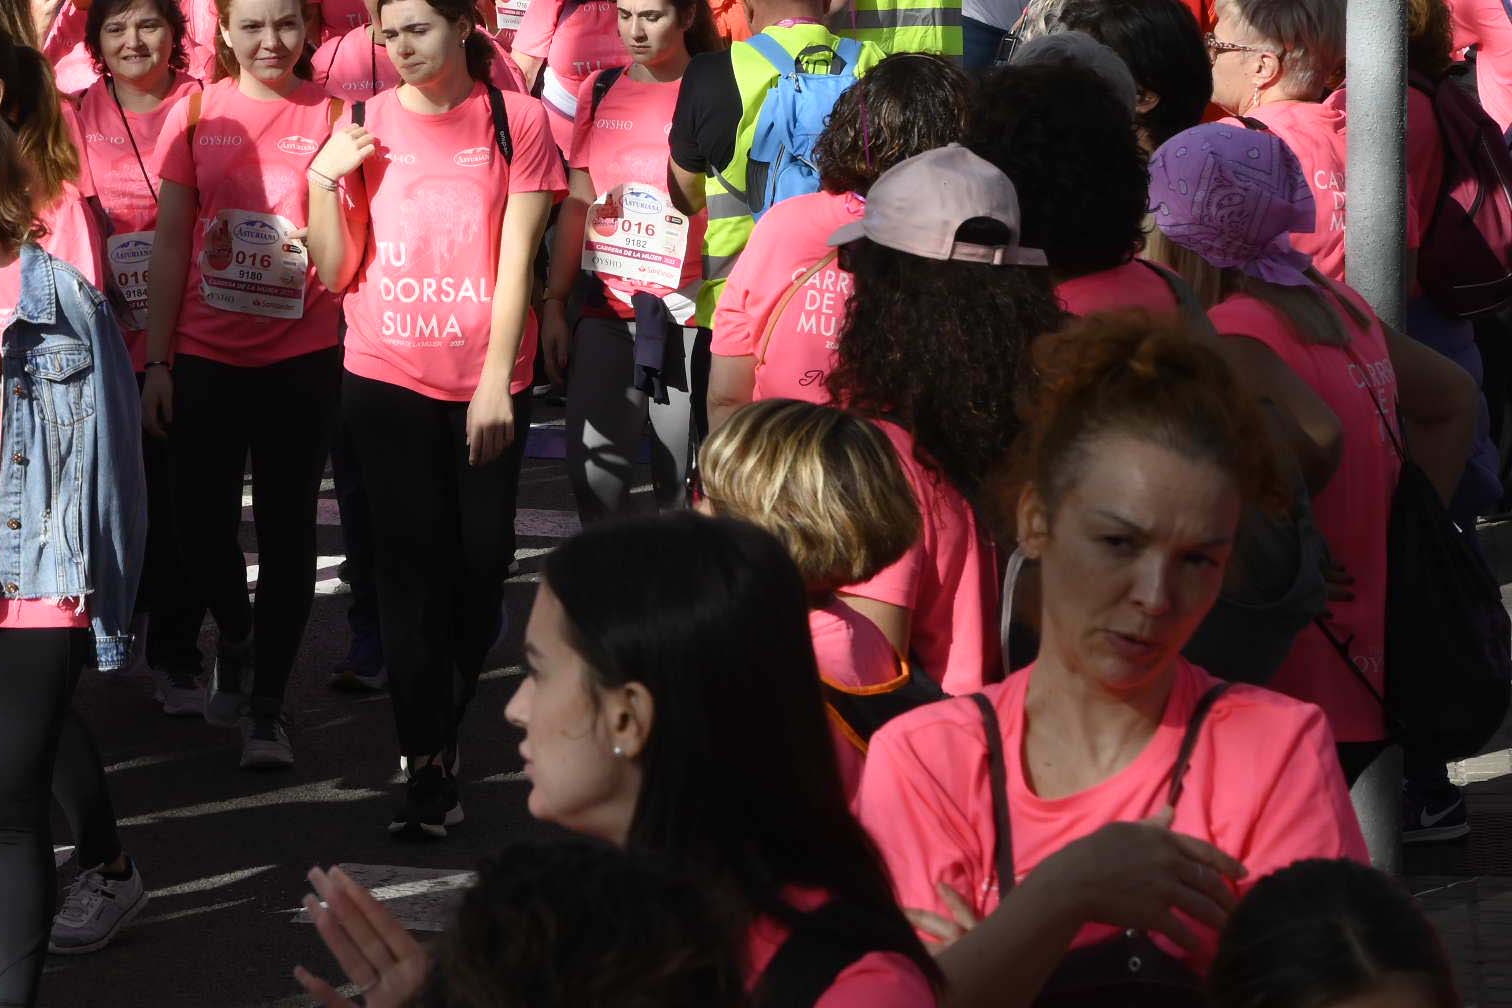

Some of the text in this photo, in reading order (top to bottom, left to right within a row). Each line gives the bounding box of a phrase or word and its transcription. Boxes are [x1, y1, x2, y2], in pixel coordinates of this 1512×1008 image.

[596, 119, 633, 131] OYSHO
[200, 136, 242, 146] OYSHO
[621, 219, 656, 237] 016
[625, 237, 648, 248] 9182
[236, 251, 272, 268] 016
[377, 242, 407, 267] TU
[239, 270, 263, 281] 9180
[380, 277, 495, 303] DORSAL
[381, 310, 463, 338] SUMA
